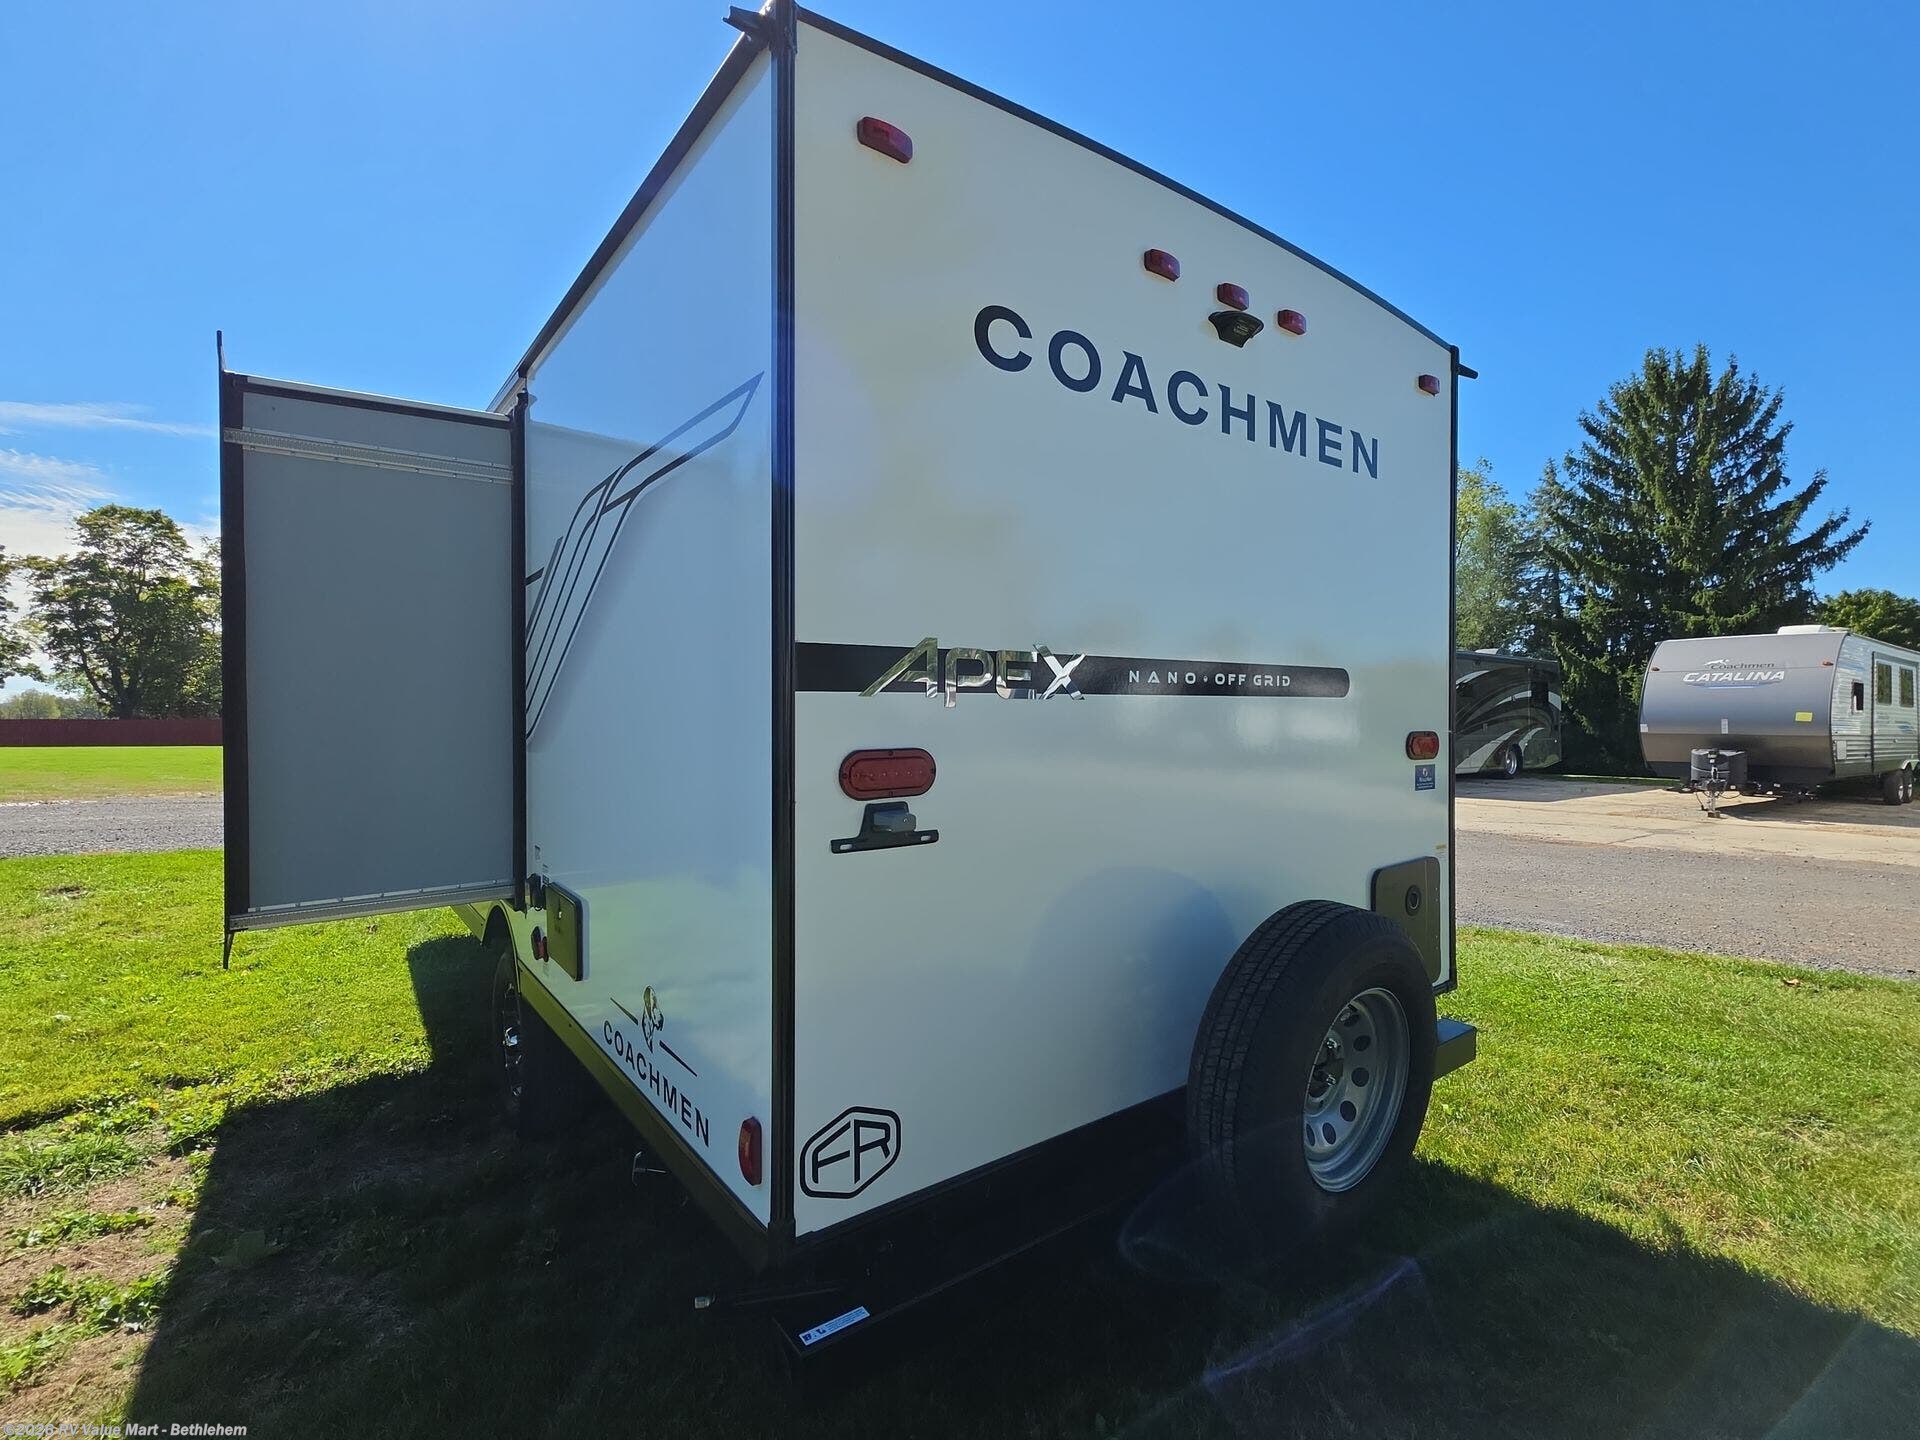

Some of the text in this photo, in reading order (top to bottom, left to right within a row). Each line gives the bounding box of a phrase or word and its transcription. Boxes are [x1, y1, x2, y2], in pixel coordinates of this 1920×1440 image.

[974, 304, 1380, 480] COACHMEN
[857, 637, 1087, 708] APEX
[1128, 670, 1291, 687] NANO OFF GRID
[1682, 670, 1785, 682] CATALINA
[1710, 661, 1776, 670] Coachmen
[603, 1020, 710, 1148] COACHMEN
